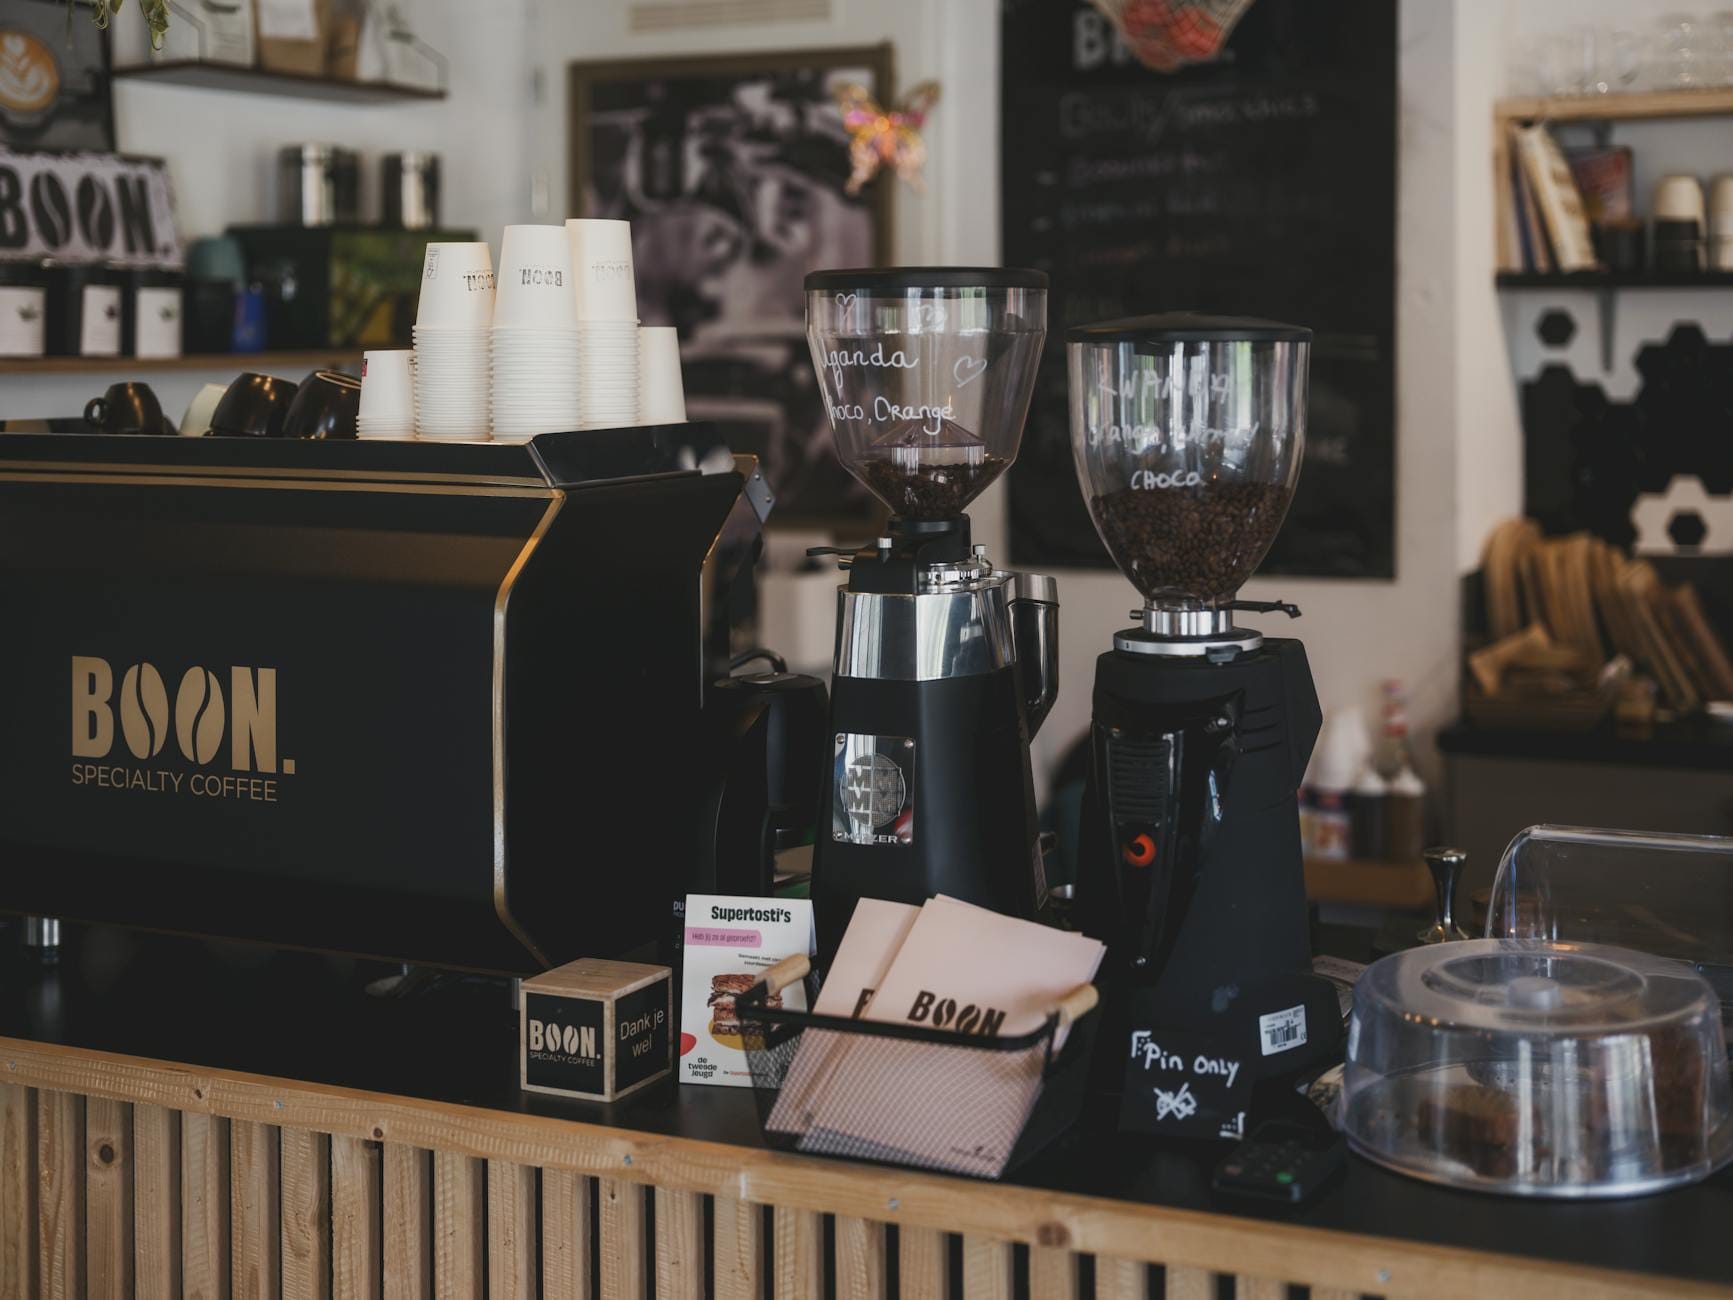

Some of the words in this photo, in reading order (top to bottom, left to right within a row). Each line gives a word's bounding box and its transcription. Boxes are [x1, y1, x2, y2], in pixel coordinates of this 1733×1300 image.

[71, 655, 296, 774] BOON.
[71, 763, 183, 793] SPECIALTY
[189, 774, 277, 802] COFFEE
[843, 831, 898, 844] MZER
[711, 904, 792, 923] Supertosti's
[620, 1017, 651, 1041] Dank
[651, 1008, 665, 1031] je
[529, 1019, 601, 1059] BOON.
[632, 1034, 652, 1058] wel
[529, 1051, 566, 1064] SPECIALTY
[567, 1056, 596, 1067] COFFEE
[1144, 1042, 1185, 1070] Pin
